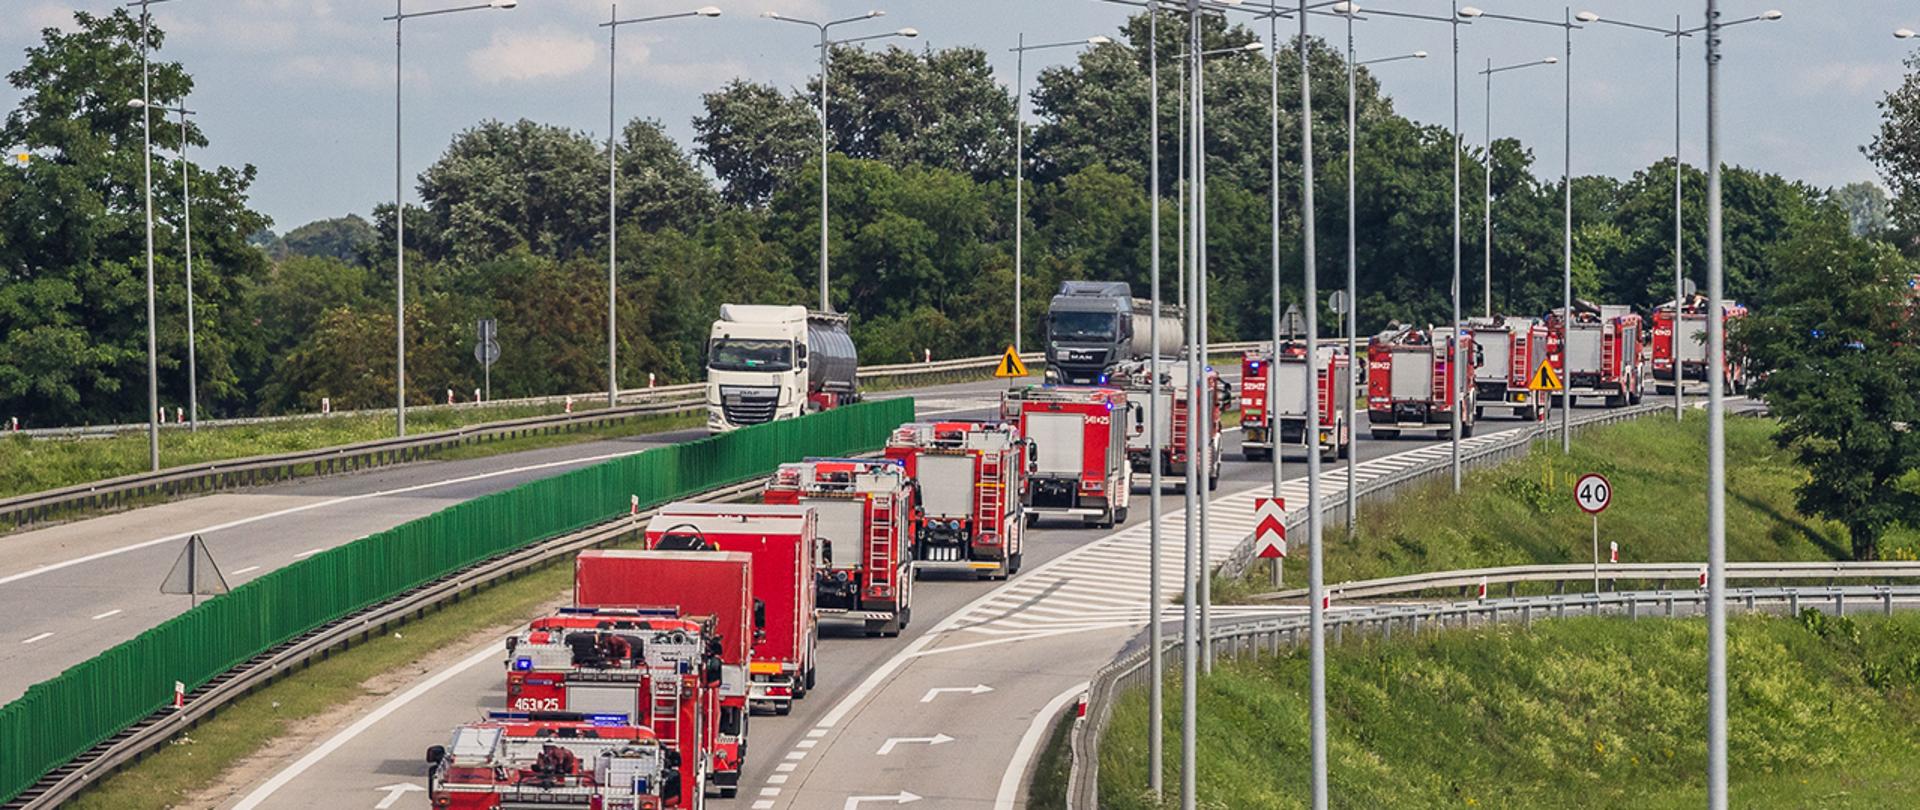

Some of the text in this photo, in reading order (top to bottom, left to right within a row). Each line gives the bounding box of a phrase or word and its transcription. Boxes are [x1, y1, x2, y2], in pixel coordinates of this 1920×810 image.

[1580, 484, 1607, 503] 40
[515, 698, 559, 711] 463 25
